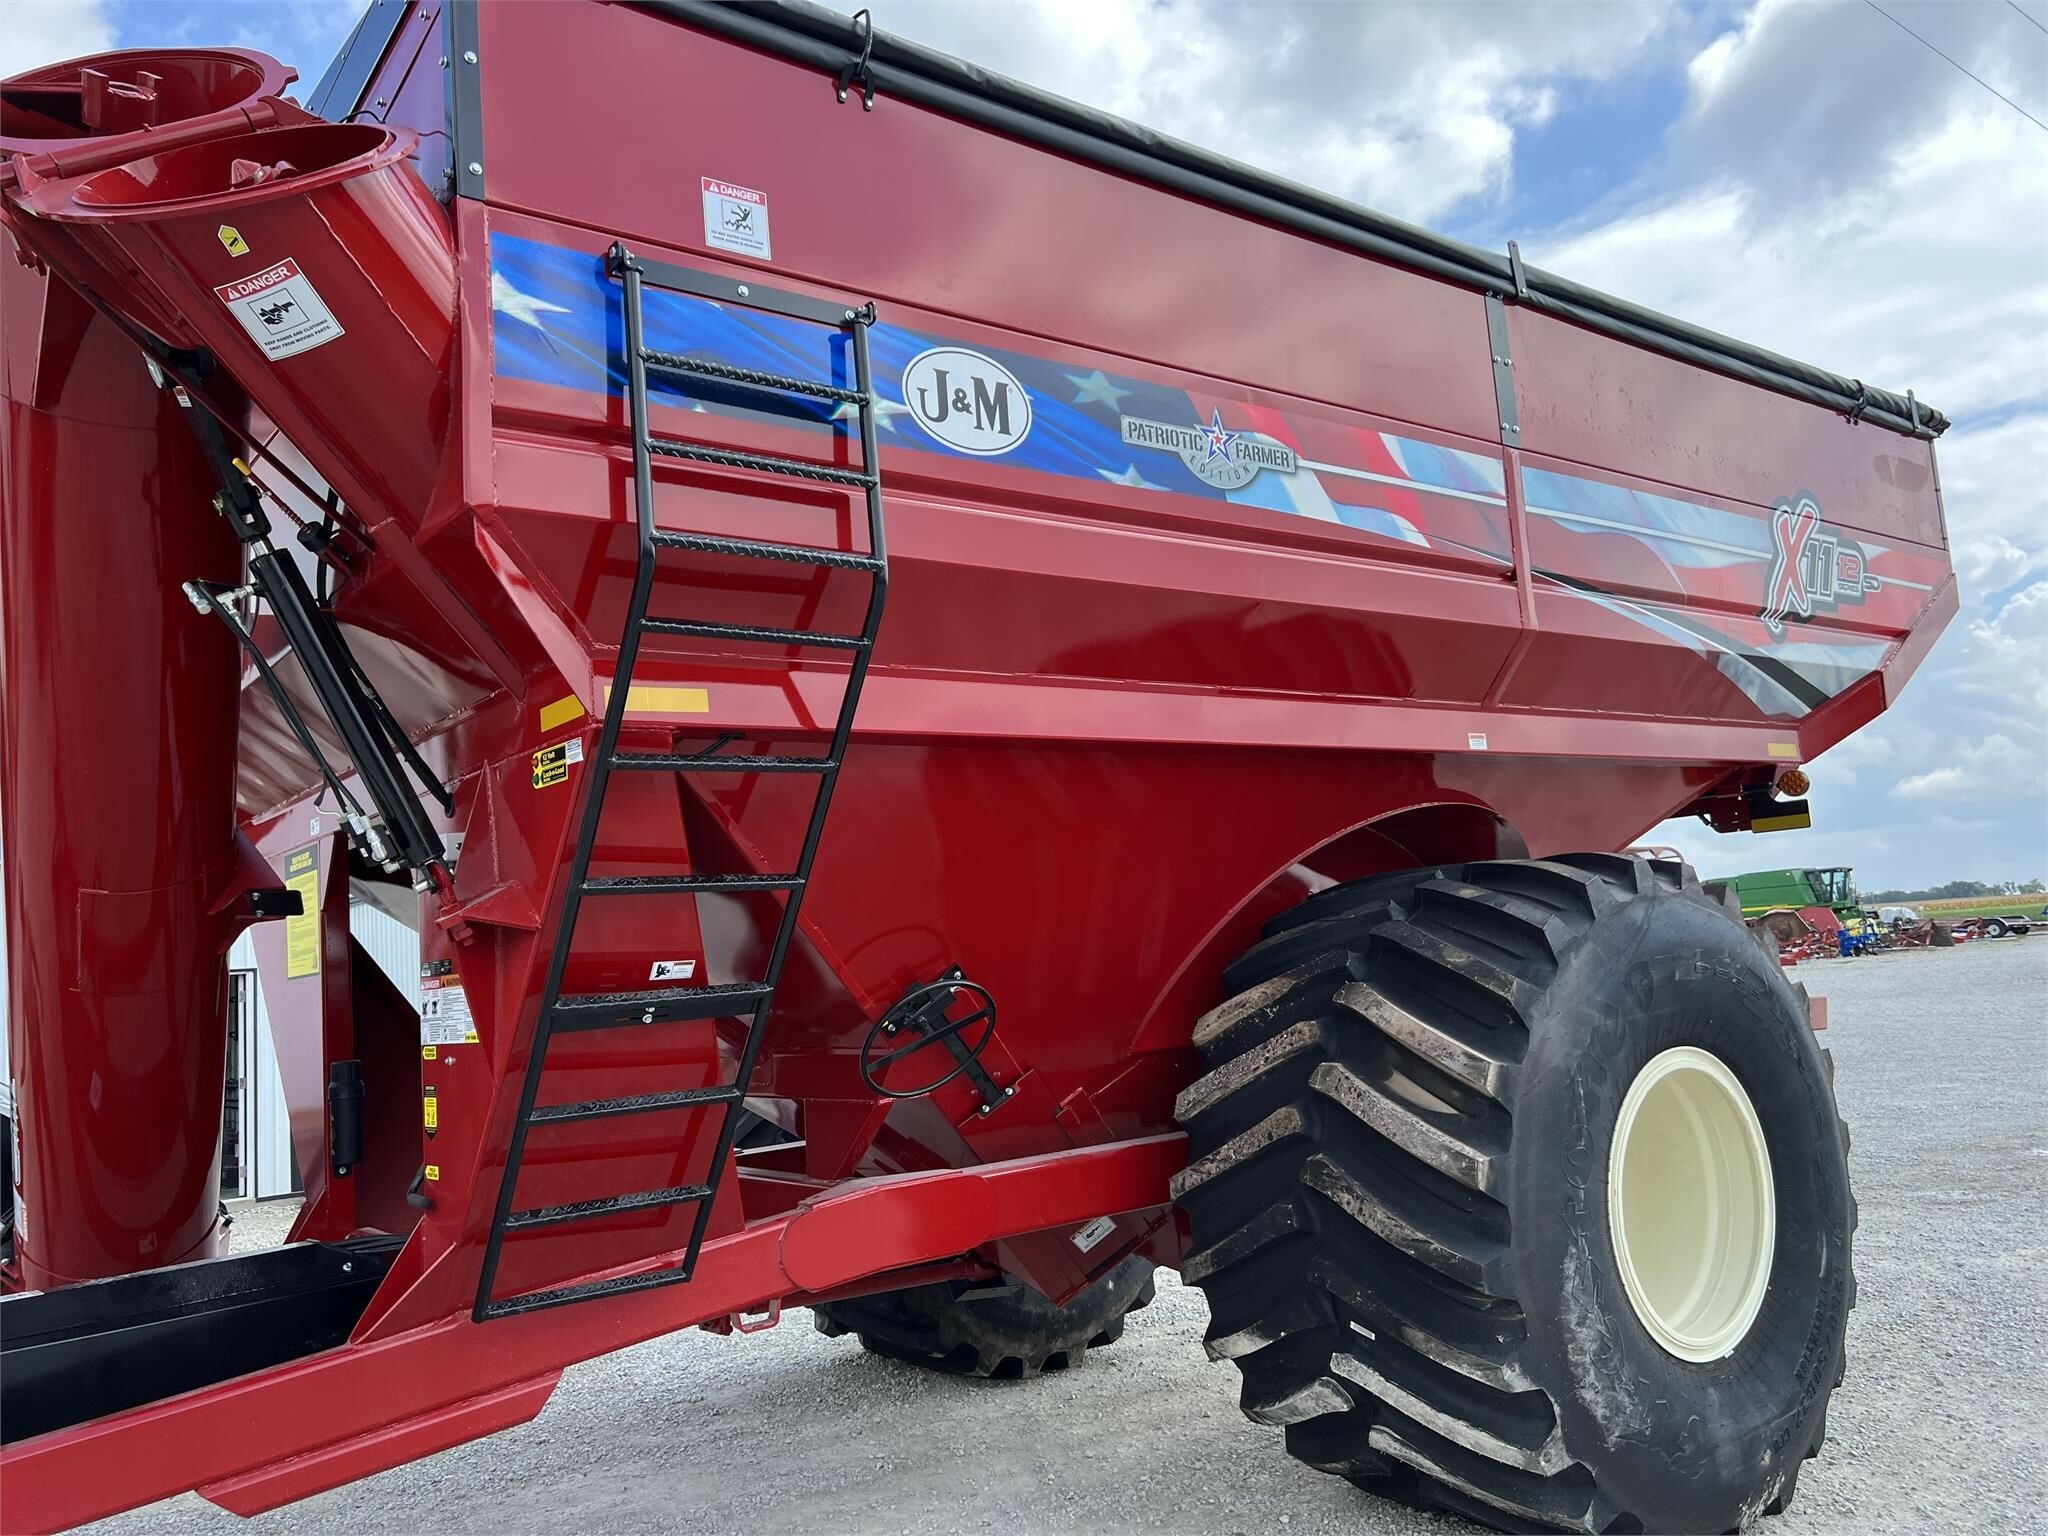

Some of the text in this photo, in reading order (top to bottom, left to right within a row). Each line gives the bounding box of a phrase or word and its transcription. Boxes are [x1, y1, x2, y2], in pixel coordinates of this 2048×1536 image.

[720, 184, 761, 203] DANGER
[237, 266, 291, 296] DANGER
[303, 318, 328, 333] CLOTHING
[917, 368, 1012, 436] J&M
[1128, 420, 1290, 468] PATRIOTIC FARMER
[1189, 455, 1250, 481] EDITION
